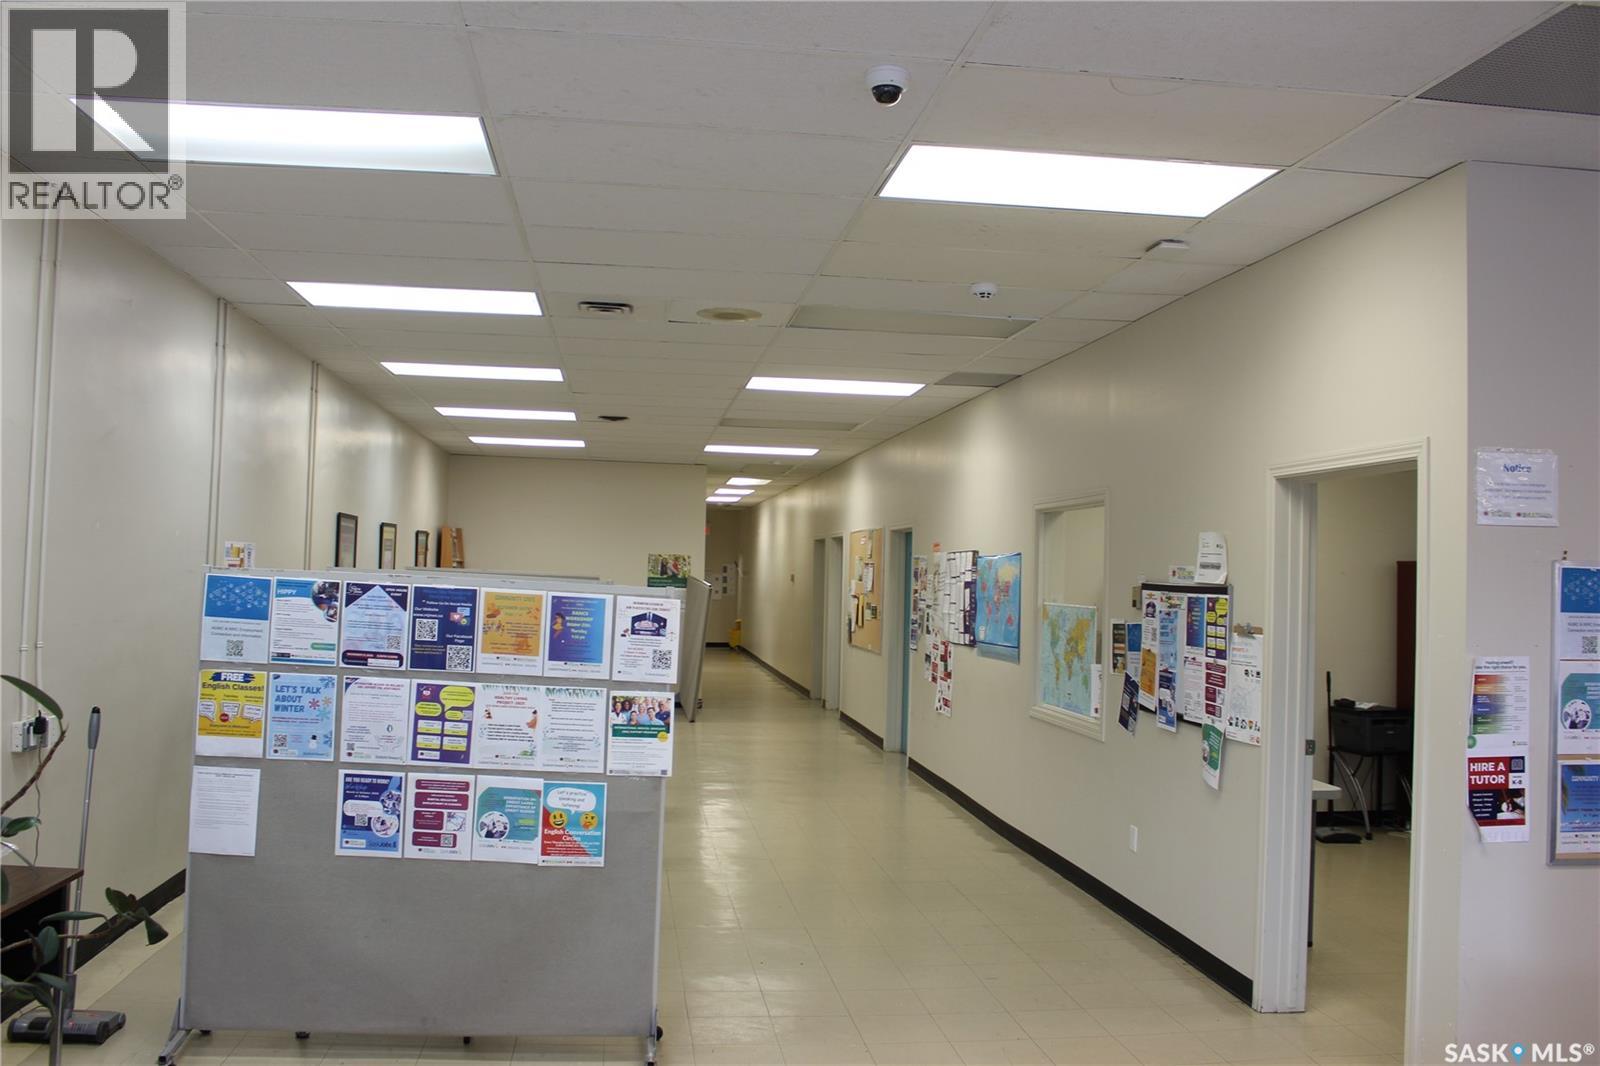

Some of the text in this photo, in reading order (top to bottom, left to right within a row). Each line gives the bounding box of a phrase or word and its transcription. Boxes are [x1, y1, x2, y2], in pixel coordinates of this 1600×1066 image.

[1503, 463, 1532, 473] Notice
[221, 672, 245, 682] FREE
[202, 681, 264, 691] English Classes!
[275, 685, 321, 694] LET'S TALK
[275, 695, 303, 703] ABOUT
[274, 704, 305, 713] WINTER
[1470, 762, 1505, 771] HIRE A
[1470, 775, 1505, 784] TUTOR
